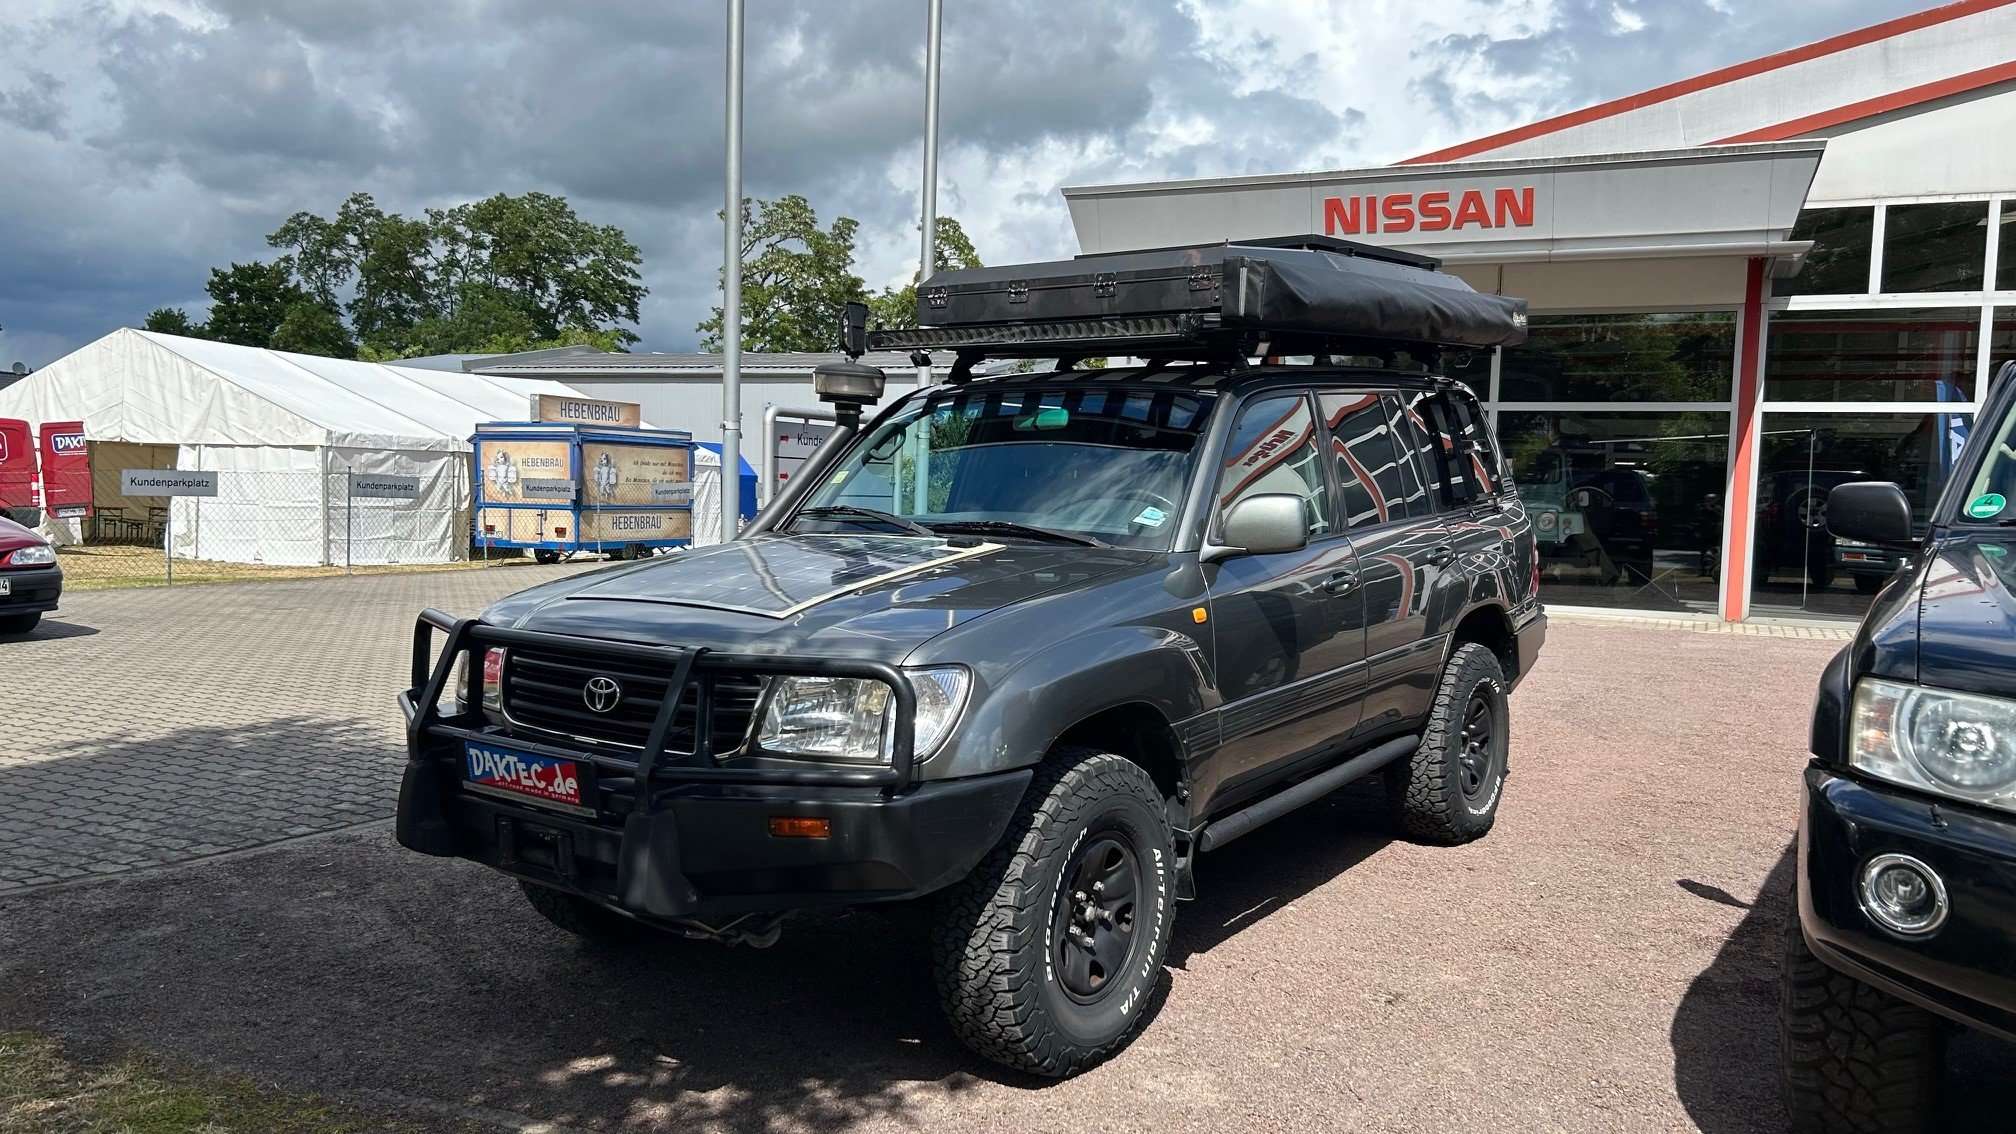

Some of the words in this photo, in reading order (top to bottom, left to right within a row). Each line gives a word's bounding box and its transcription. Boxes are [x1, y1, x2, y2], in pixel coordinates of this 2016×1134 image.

[1323, 186, 1535, 236] NISSAN
[559, 400, 621, 423] HEBENBRÄU
[129, 476, 210, 489] Kundenparkplatz
[356, 481, 414, 492] Kundenparkplatz
[525, 484, 571, 494] Kundenparkplatz
[654, 487, 691, 496] Kundenparkplatz
[1983, 497, 1993, 506] 4
[1141, 847, 1167, 978] All-Terrain
[1119, 985, 1141, 1016] T/A
